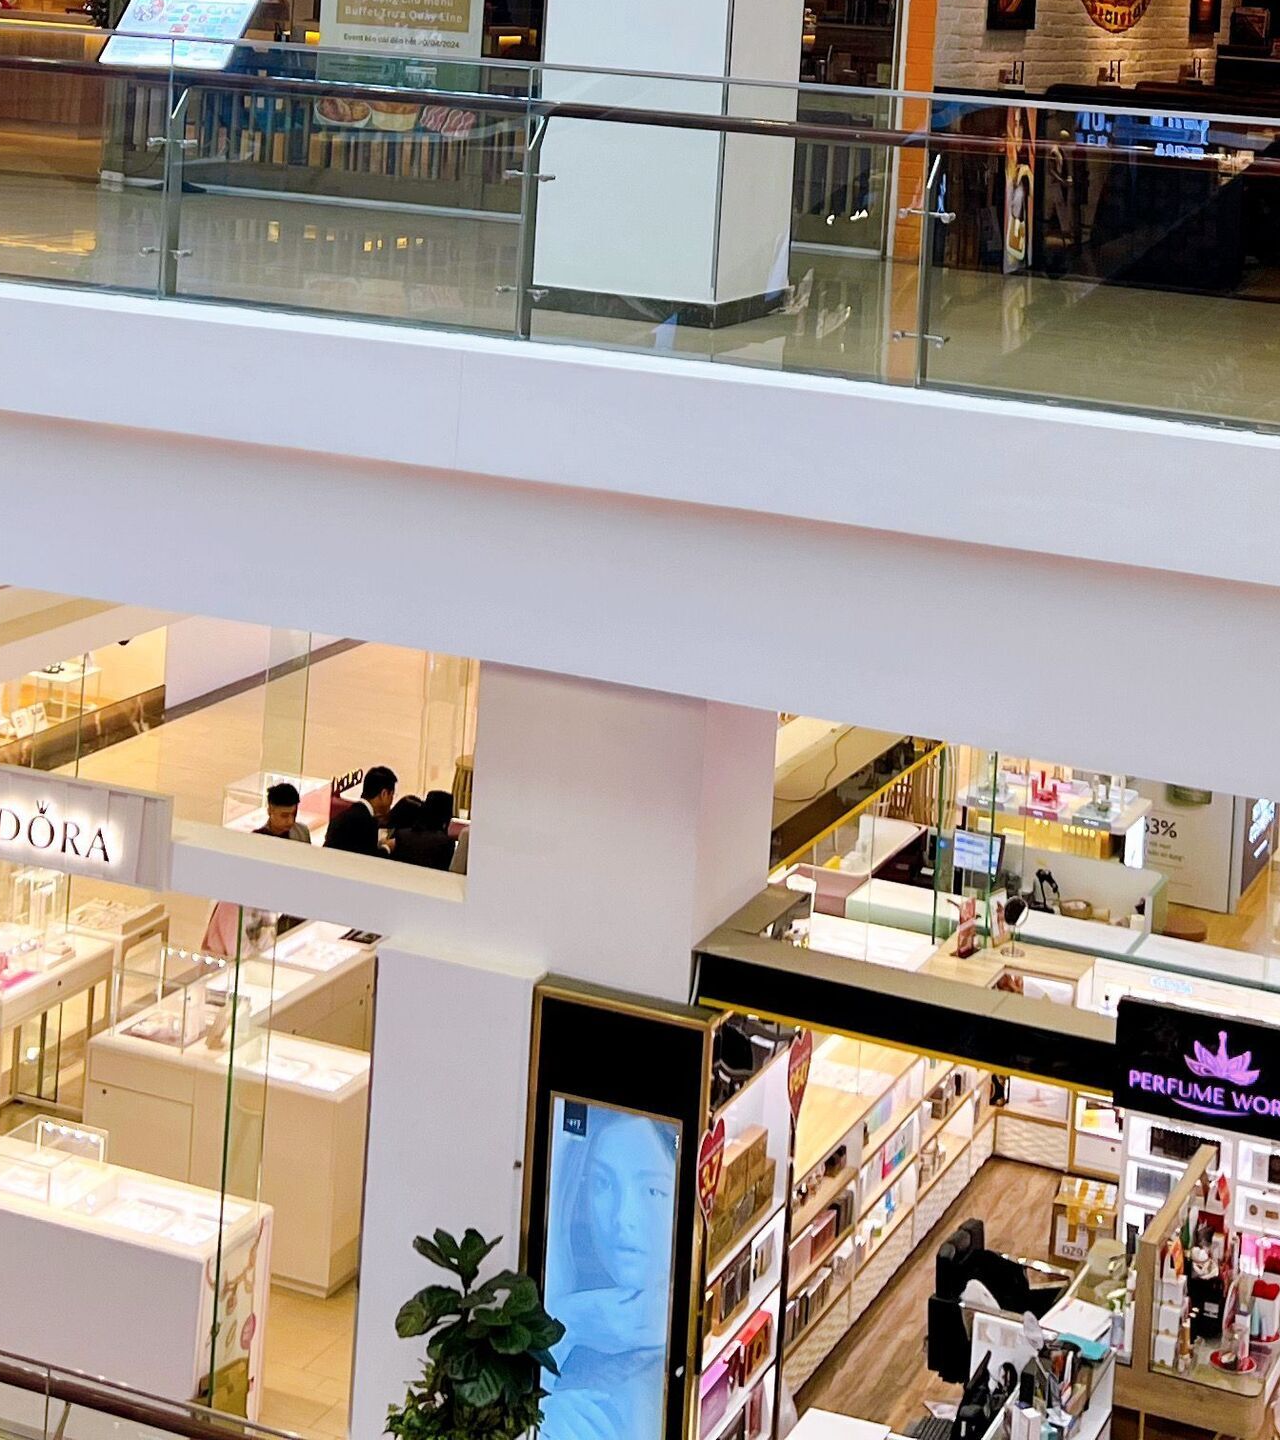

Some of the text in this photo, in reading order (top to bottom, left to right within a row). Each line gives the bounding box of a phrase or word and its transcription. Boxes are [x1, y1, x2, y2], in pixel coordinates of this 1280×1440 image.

[344, 6, 378, 18] Buffet
[438, 12, 463, 23] Line
[343, 32, 364, 42] Event
[1128, 1069, 1225, 1106] PERFUME
